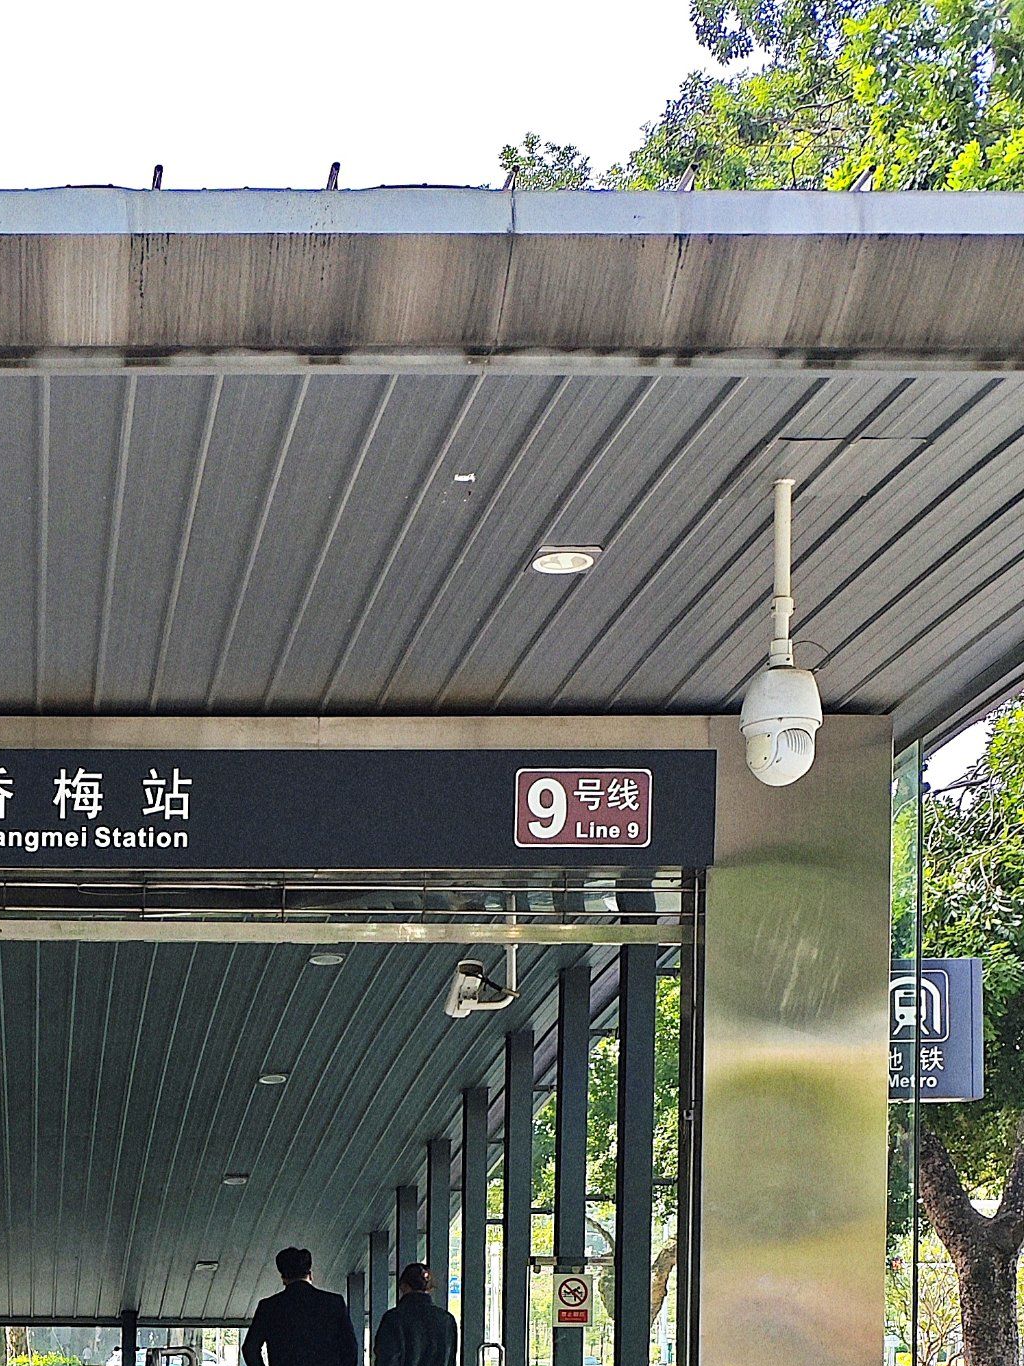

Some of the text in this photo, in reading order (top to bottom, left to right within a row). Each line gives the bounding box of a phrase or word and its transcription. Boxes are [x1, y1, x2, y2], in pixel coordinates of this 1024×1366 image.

[94, 827, 188, 848] Station
[576, 821, 640, 839] Line 9
